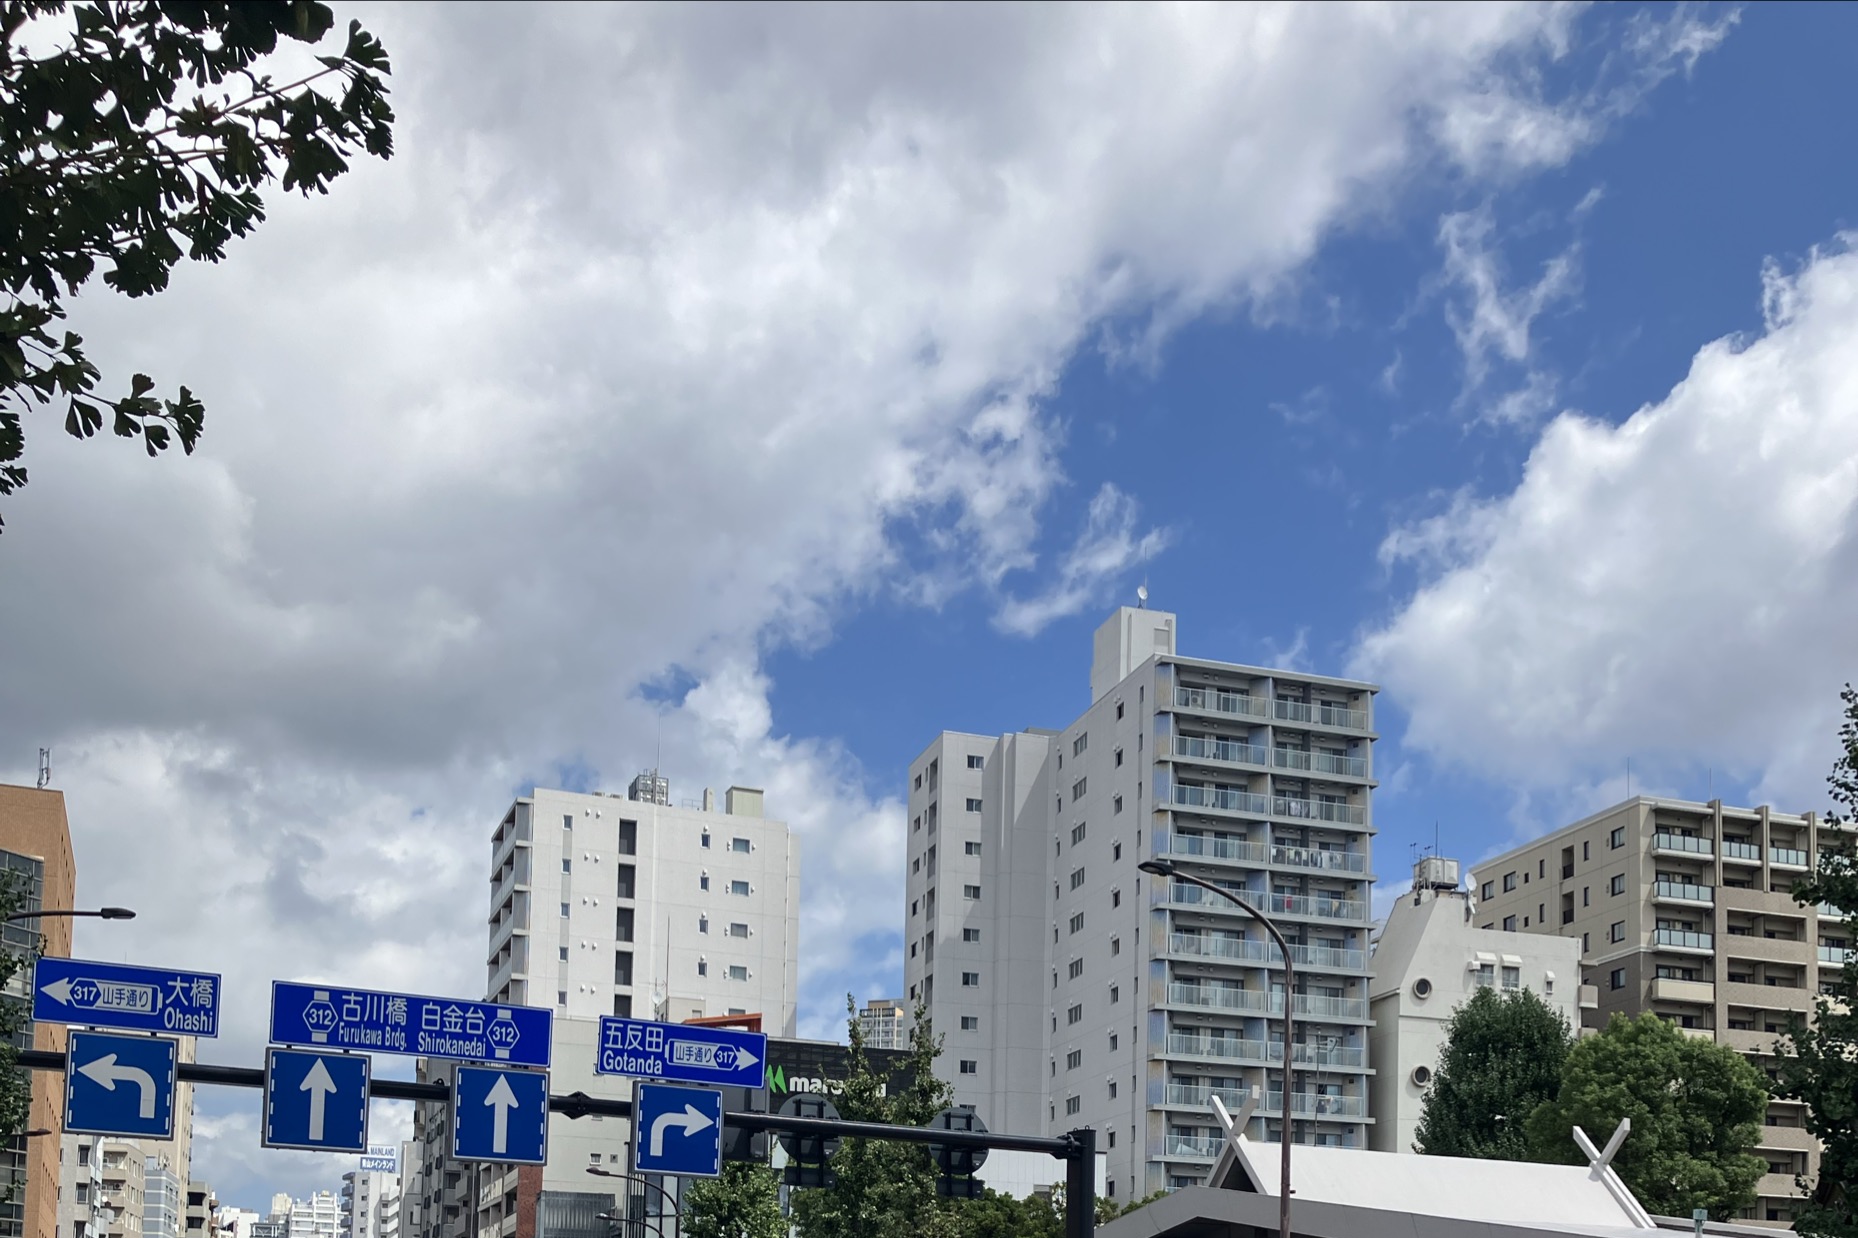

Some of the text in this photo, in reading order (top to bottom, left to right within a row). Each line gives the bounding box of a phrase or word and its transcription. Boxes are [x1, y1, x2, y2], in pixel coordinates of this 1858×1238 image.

[73, 975, 213, 1009] 317 山手通り 大橋
[164, 1006, 213, 1032] Ohashi
[308, 992, 515, 1043] 312 古川橋 白金台 312
[338, 1021, 486, 1057] Furukawa Brdg. Shirokanedai
[604, 1022, 735, 1064] 五反田 山手通り 317
[603, 1050, 662, 1075] Gotanda
[370, 1146, 395, 1157] MAINLAND
